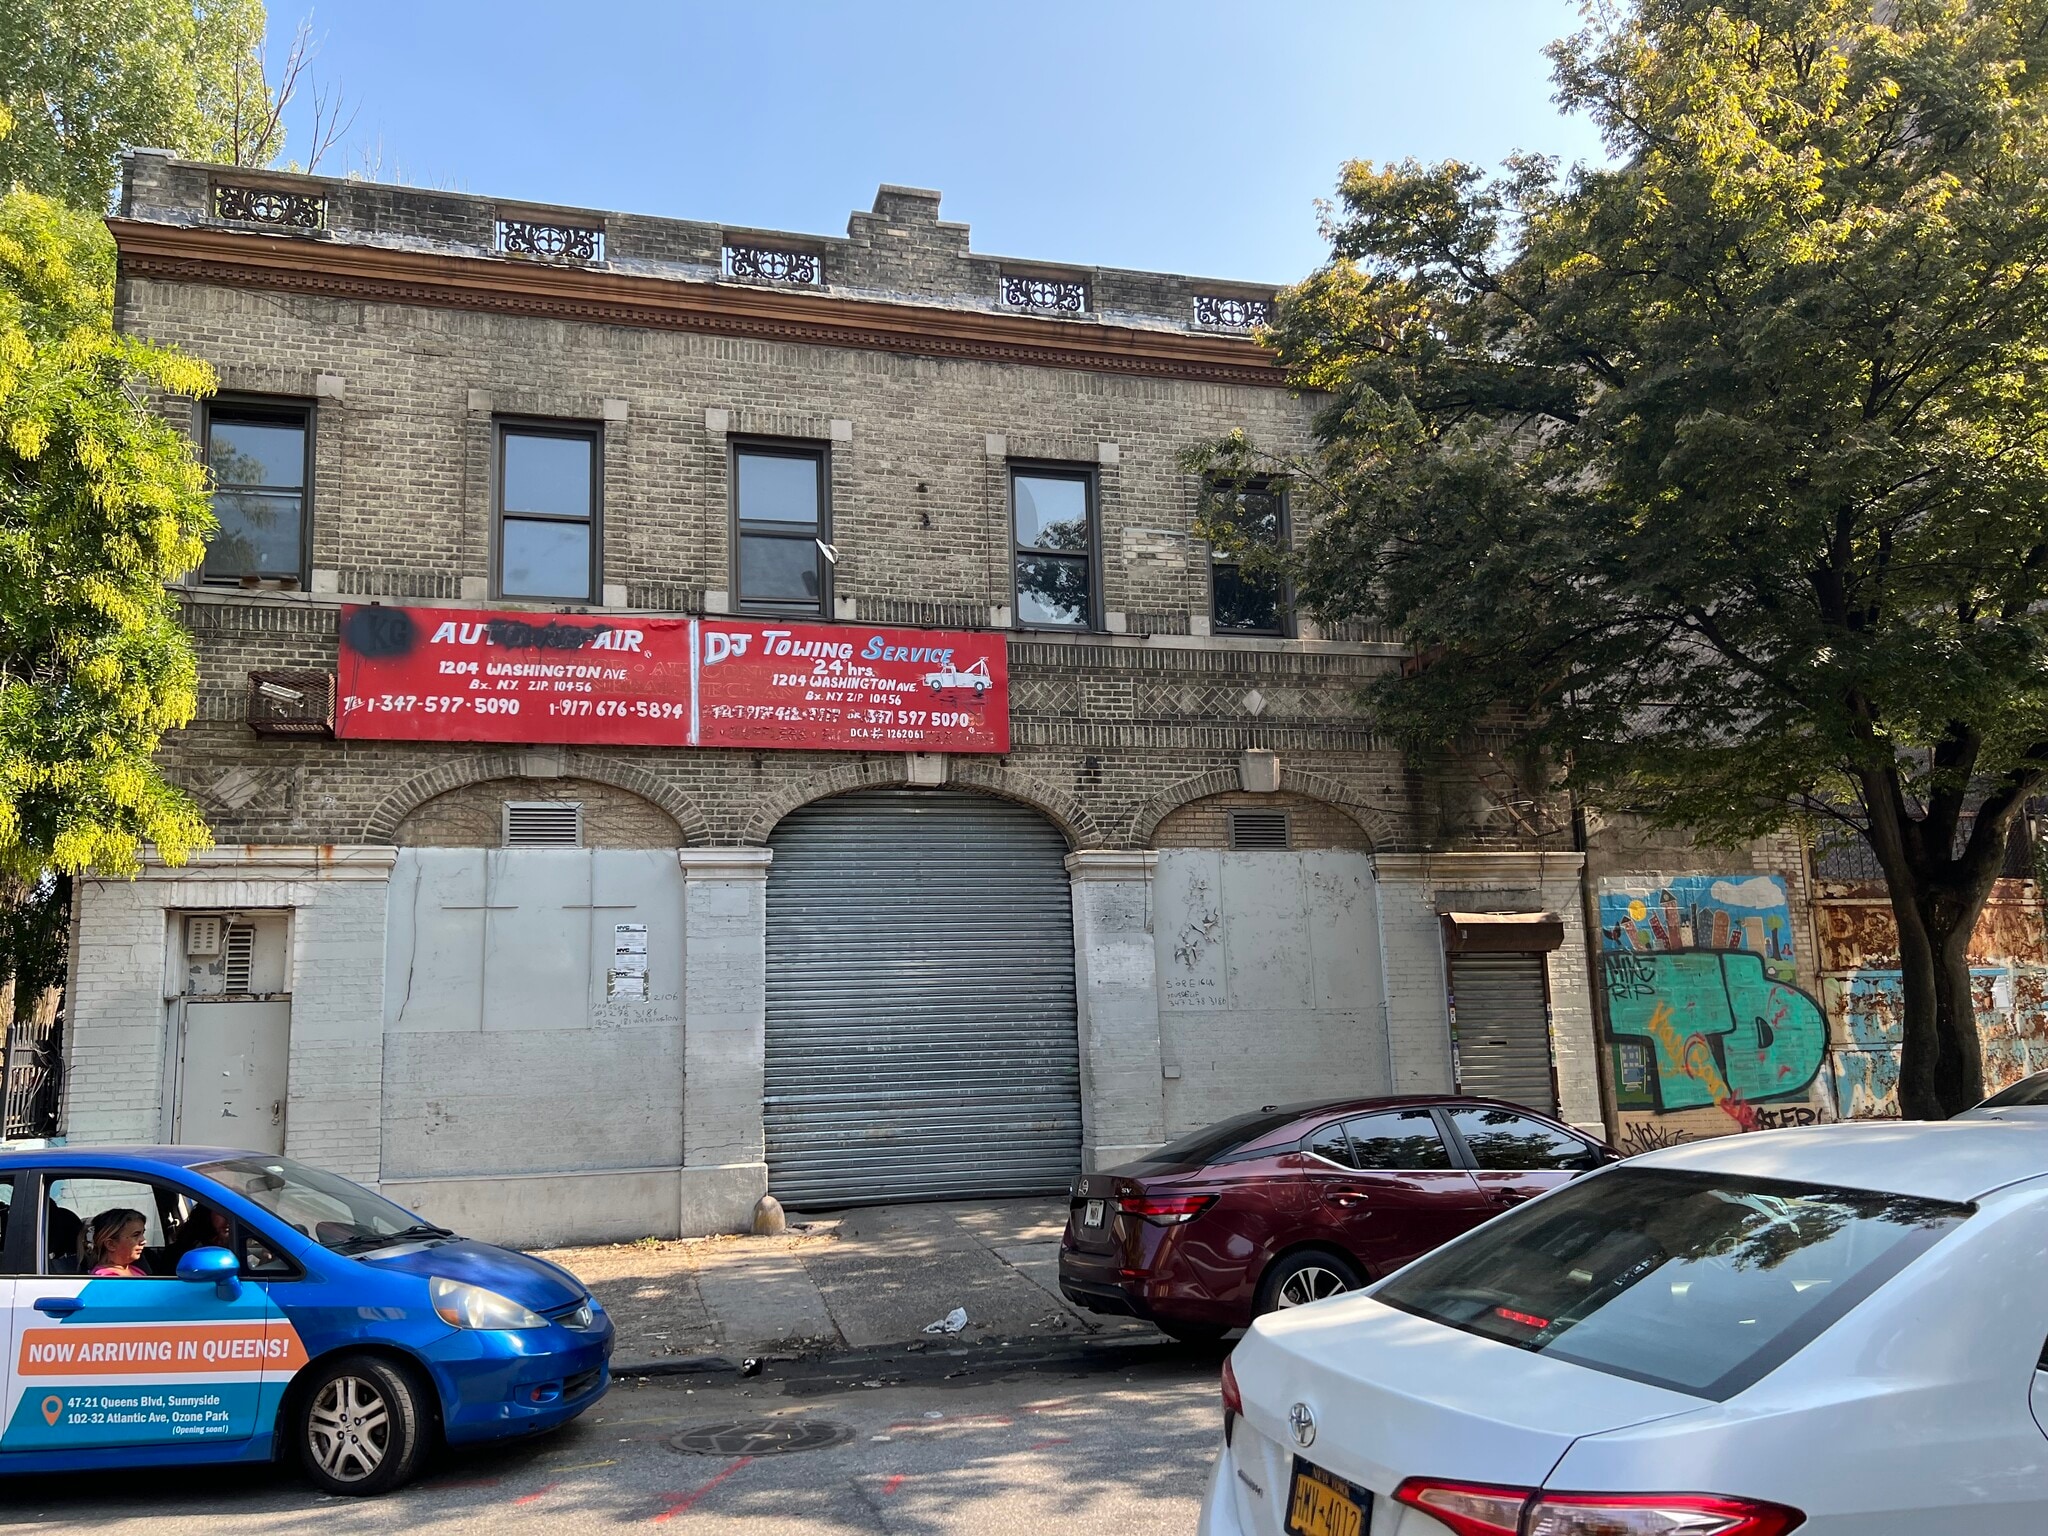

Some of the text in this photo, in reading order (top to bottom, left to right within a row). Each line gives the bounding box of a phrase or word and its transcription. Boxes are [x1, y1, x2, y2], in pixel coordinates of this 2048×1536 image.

[704, 630, 954, 666] DJ TOWING SERVICE
[439, 660, 479, 675] 1204
[486, 662, 601, 679] WASHINGTON
[554, 681, 592, 693] 10456
[772, 673, 807, 687] 1204
[809, 675, 896, 691] WASHINGTON
[869, 693, 902, 706] 10456
[898, 710, 927, 726] 597
[931, 711, 969, 727] 5090
[850, 728, 869, 738] DCA
[886, 728, 924, 739] 1262061
[29, 1338, 289, 1363] NOW ARRIVING IN QUEENS!
[67, 1394, 220, 1409] 47-21 Queens Blvd, Sunnyside
[67, 1410, 229, 1424] 102-32 Atlantic Ave, Ozone Park
[172, 1424, 229, 1435] (Opening soon!)
